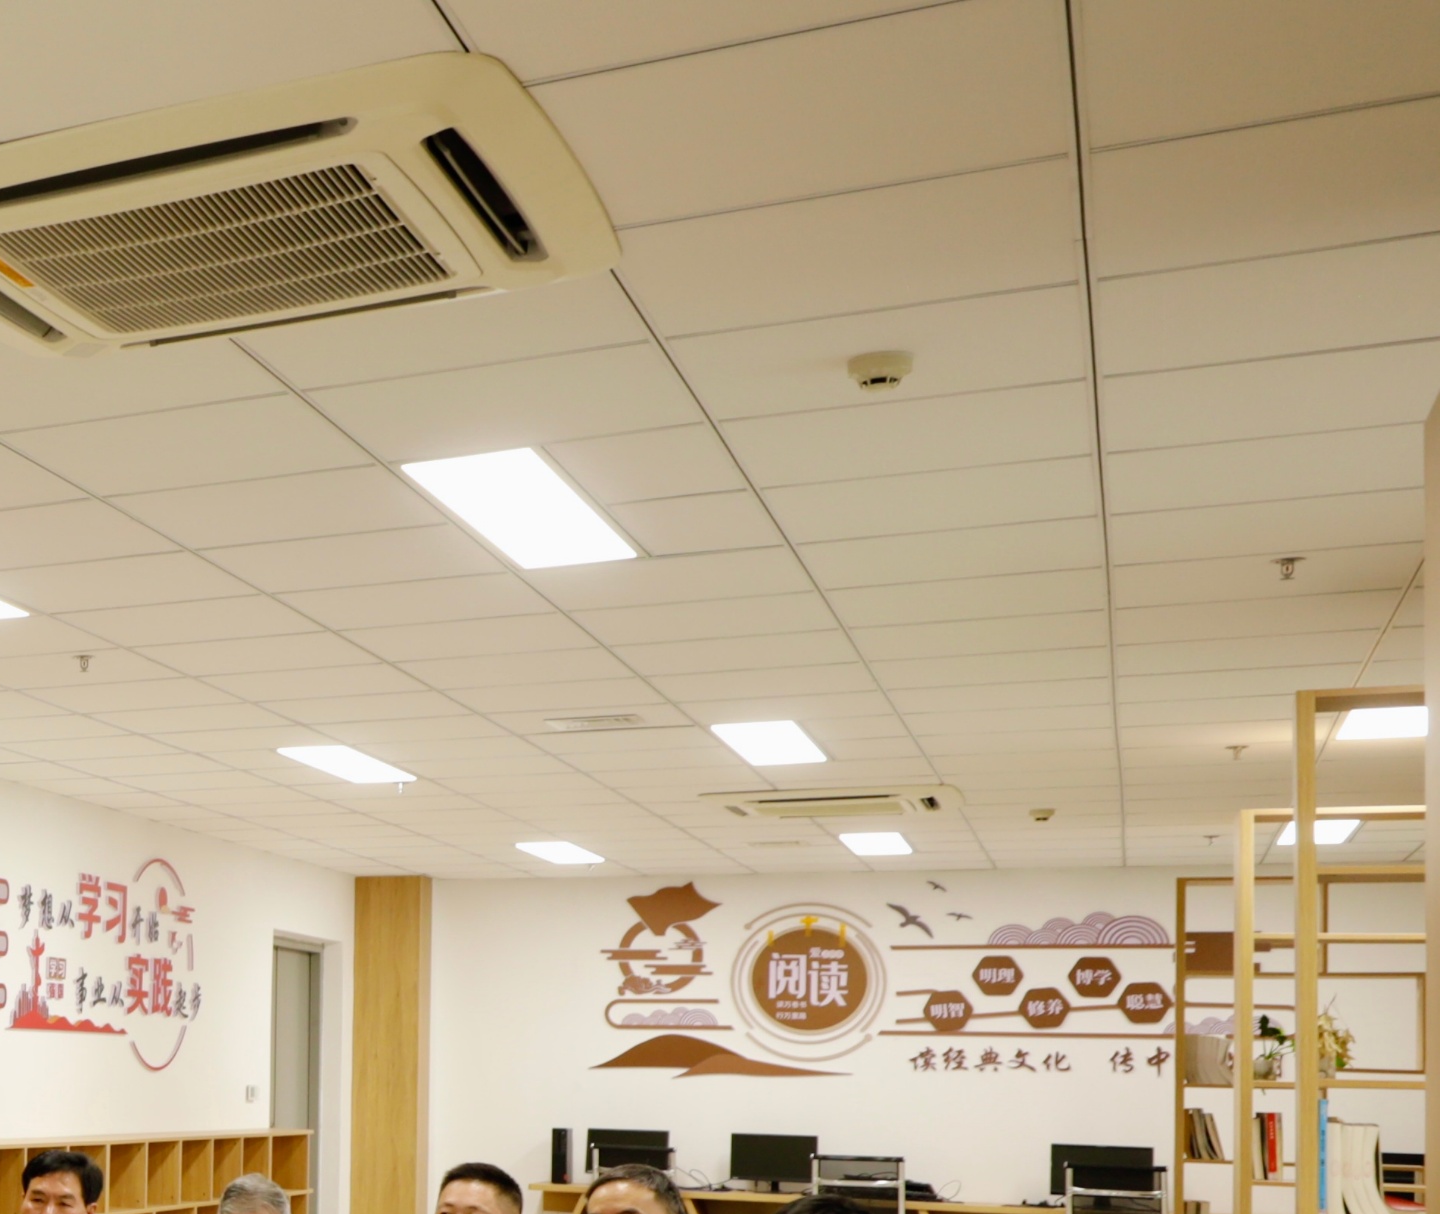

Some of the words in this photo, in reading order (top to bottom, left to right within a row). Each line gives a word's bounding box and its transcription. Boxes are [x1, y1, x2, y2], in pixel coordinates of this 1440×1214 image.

[17, 872, 160, 946] 梦想从学习开始
[767, 952, 850, 1007] 阅读
[978, 967, 1016, 985] 明理
[1075, 969, 1113, 987] 博学
[73, 953, 202, 1022] 事业从实践起步
[929, 1001, 966, 1020] 明智
[1026, 998, 1064, 1018] 修养
[1125, 993, 1165, 1011] 聪慧
